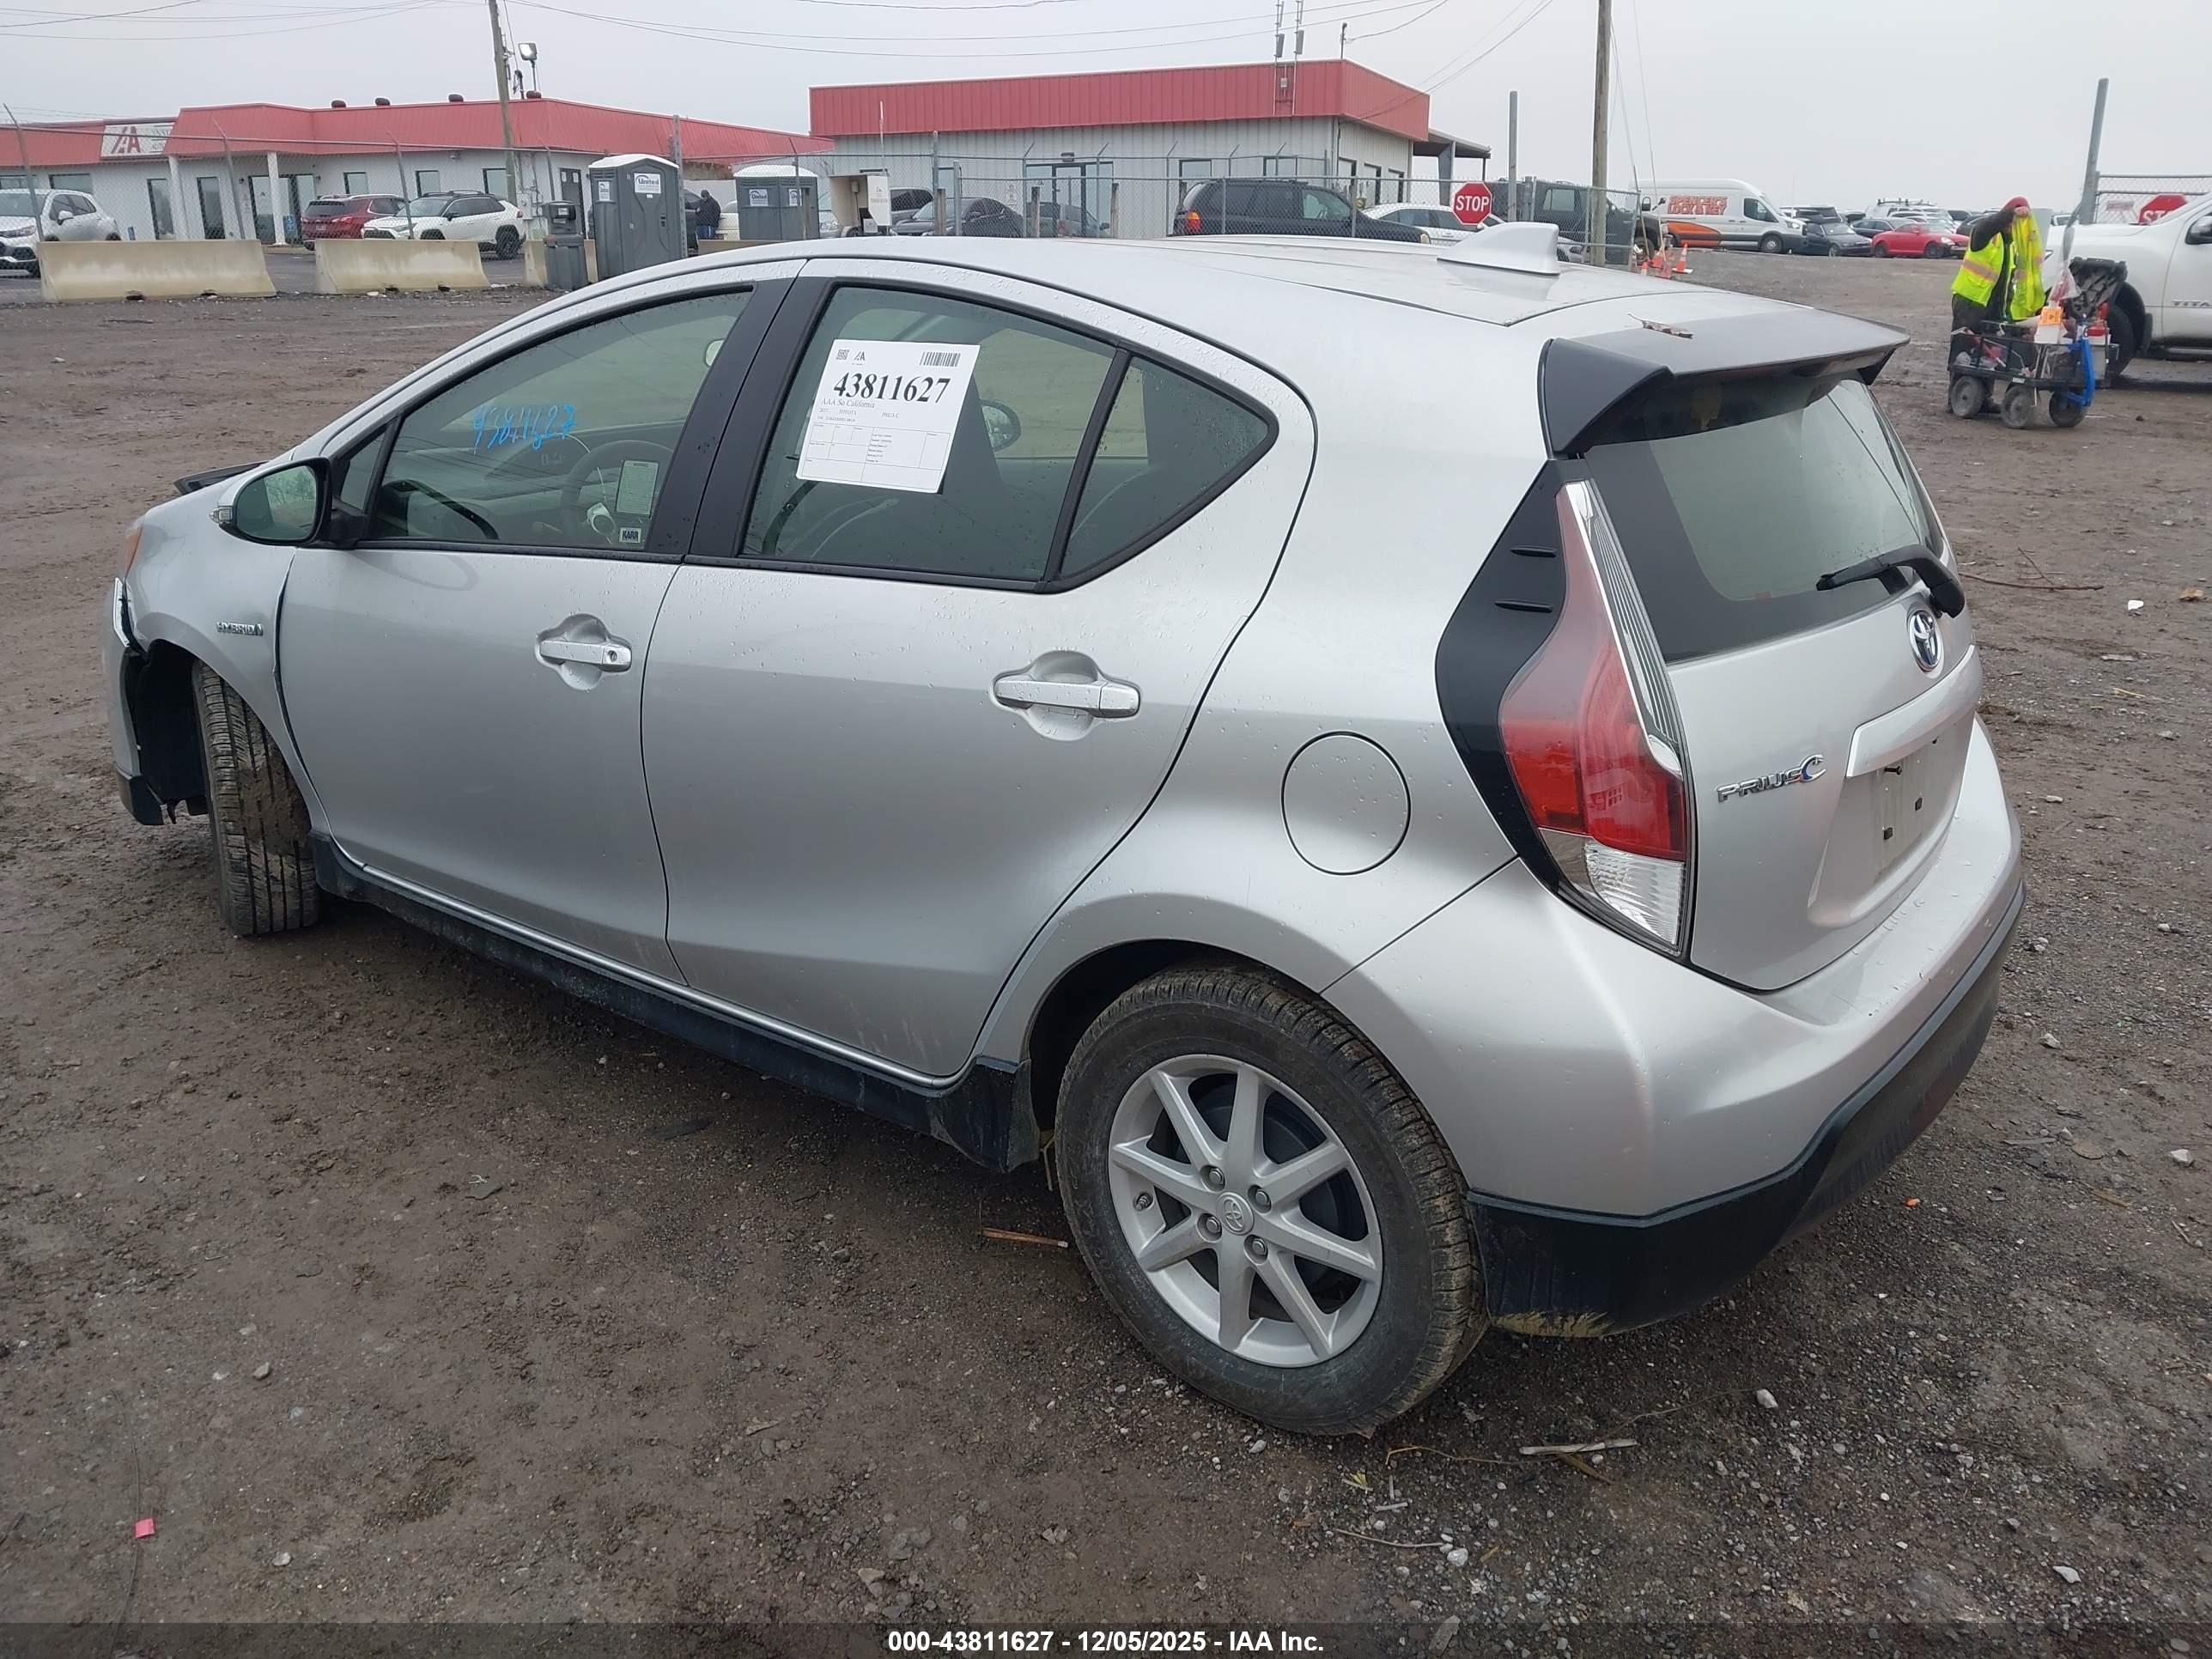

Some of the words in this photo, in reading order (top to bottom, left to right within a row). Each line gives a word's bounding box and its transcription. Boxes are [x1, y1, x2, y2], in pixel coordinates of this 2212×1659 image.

[1455, 195, 1490, 212] STOP
[834, 372, 951, 404] 43811627
[846, 398, 876, 409] California
[216, 622, 255, 635] HYBRID
[1717, 766, 1802, 802] PRIUS
